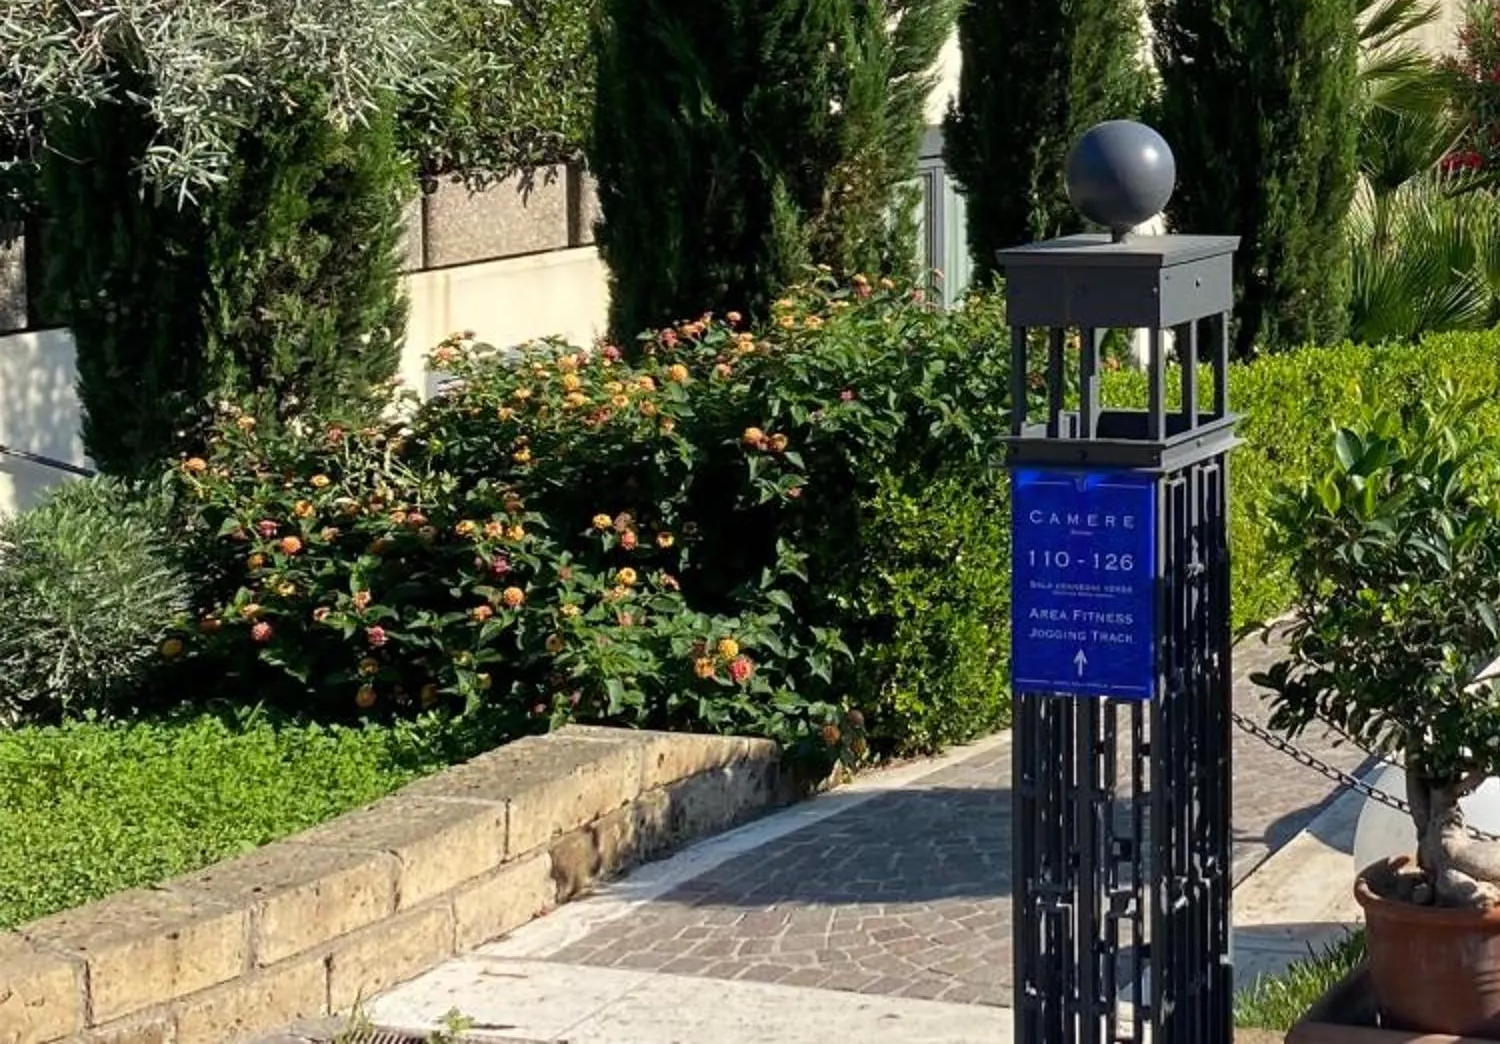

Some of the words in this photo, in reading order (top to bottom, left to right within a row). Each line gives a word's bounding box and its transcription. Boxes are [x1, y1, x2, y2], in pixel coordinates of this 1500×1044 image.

[1029, 509, 1135, 530] CAMERE
[1029, 549, 1070, 568] 110
[1093, 552, 1134, 571] 126
[1028, 607, 1067, 621] AREA
[1072, 609, 1134, 625] FITNESS
[1028, 627, 1087, 641] JOGGING
[1091, 629, 1133, 643] TRACK
